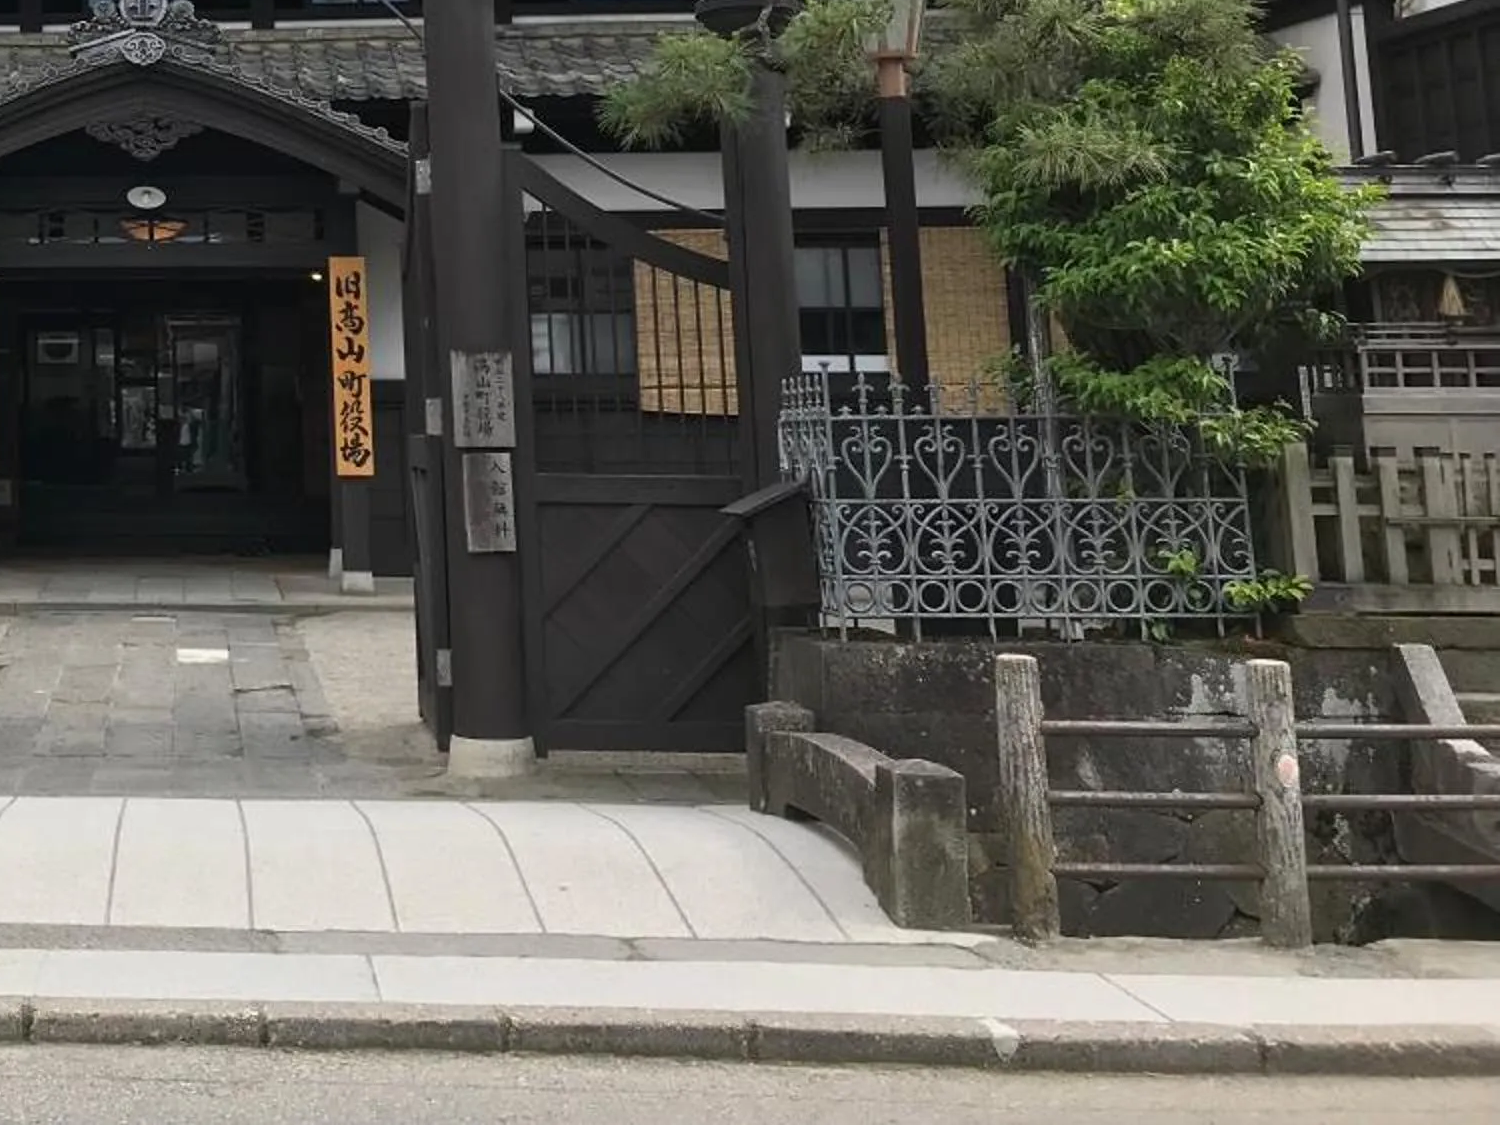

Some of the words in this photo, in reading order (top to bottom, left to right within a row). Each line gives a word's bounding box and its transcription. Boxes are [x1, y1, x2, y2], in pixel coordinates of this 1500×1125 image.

[334, 271, 371, 468] 旧高山町役場
